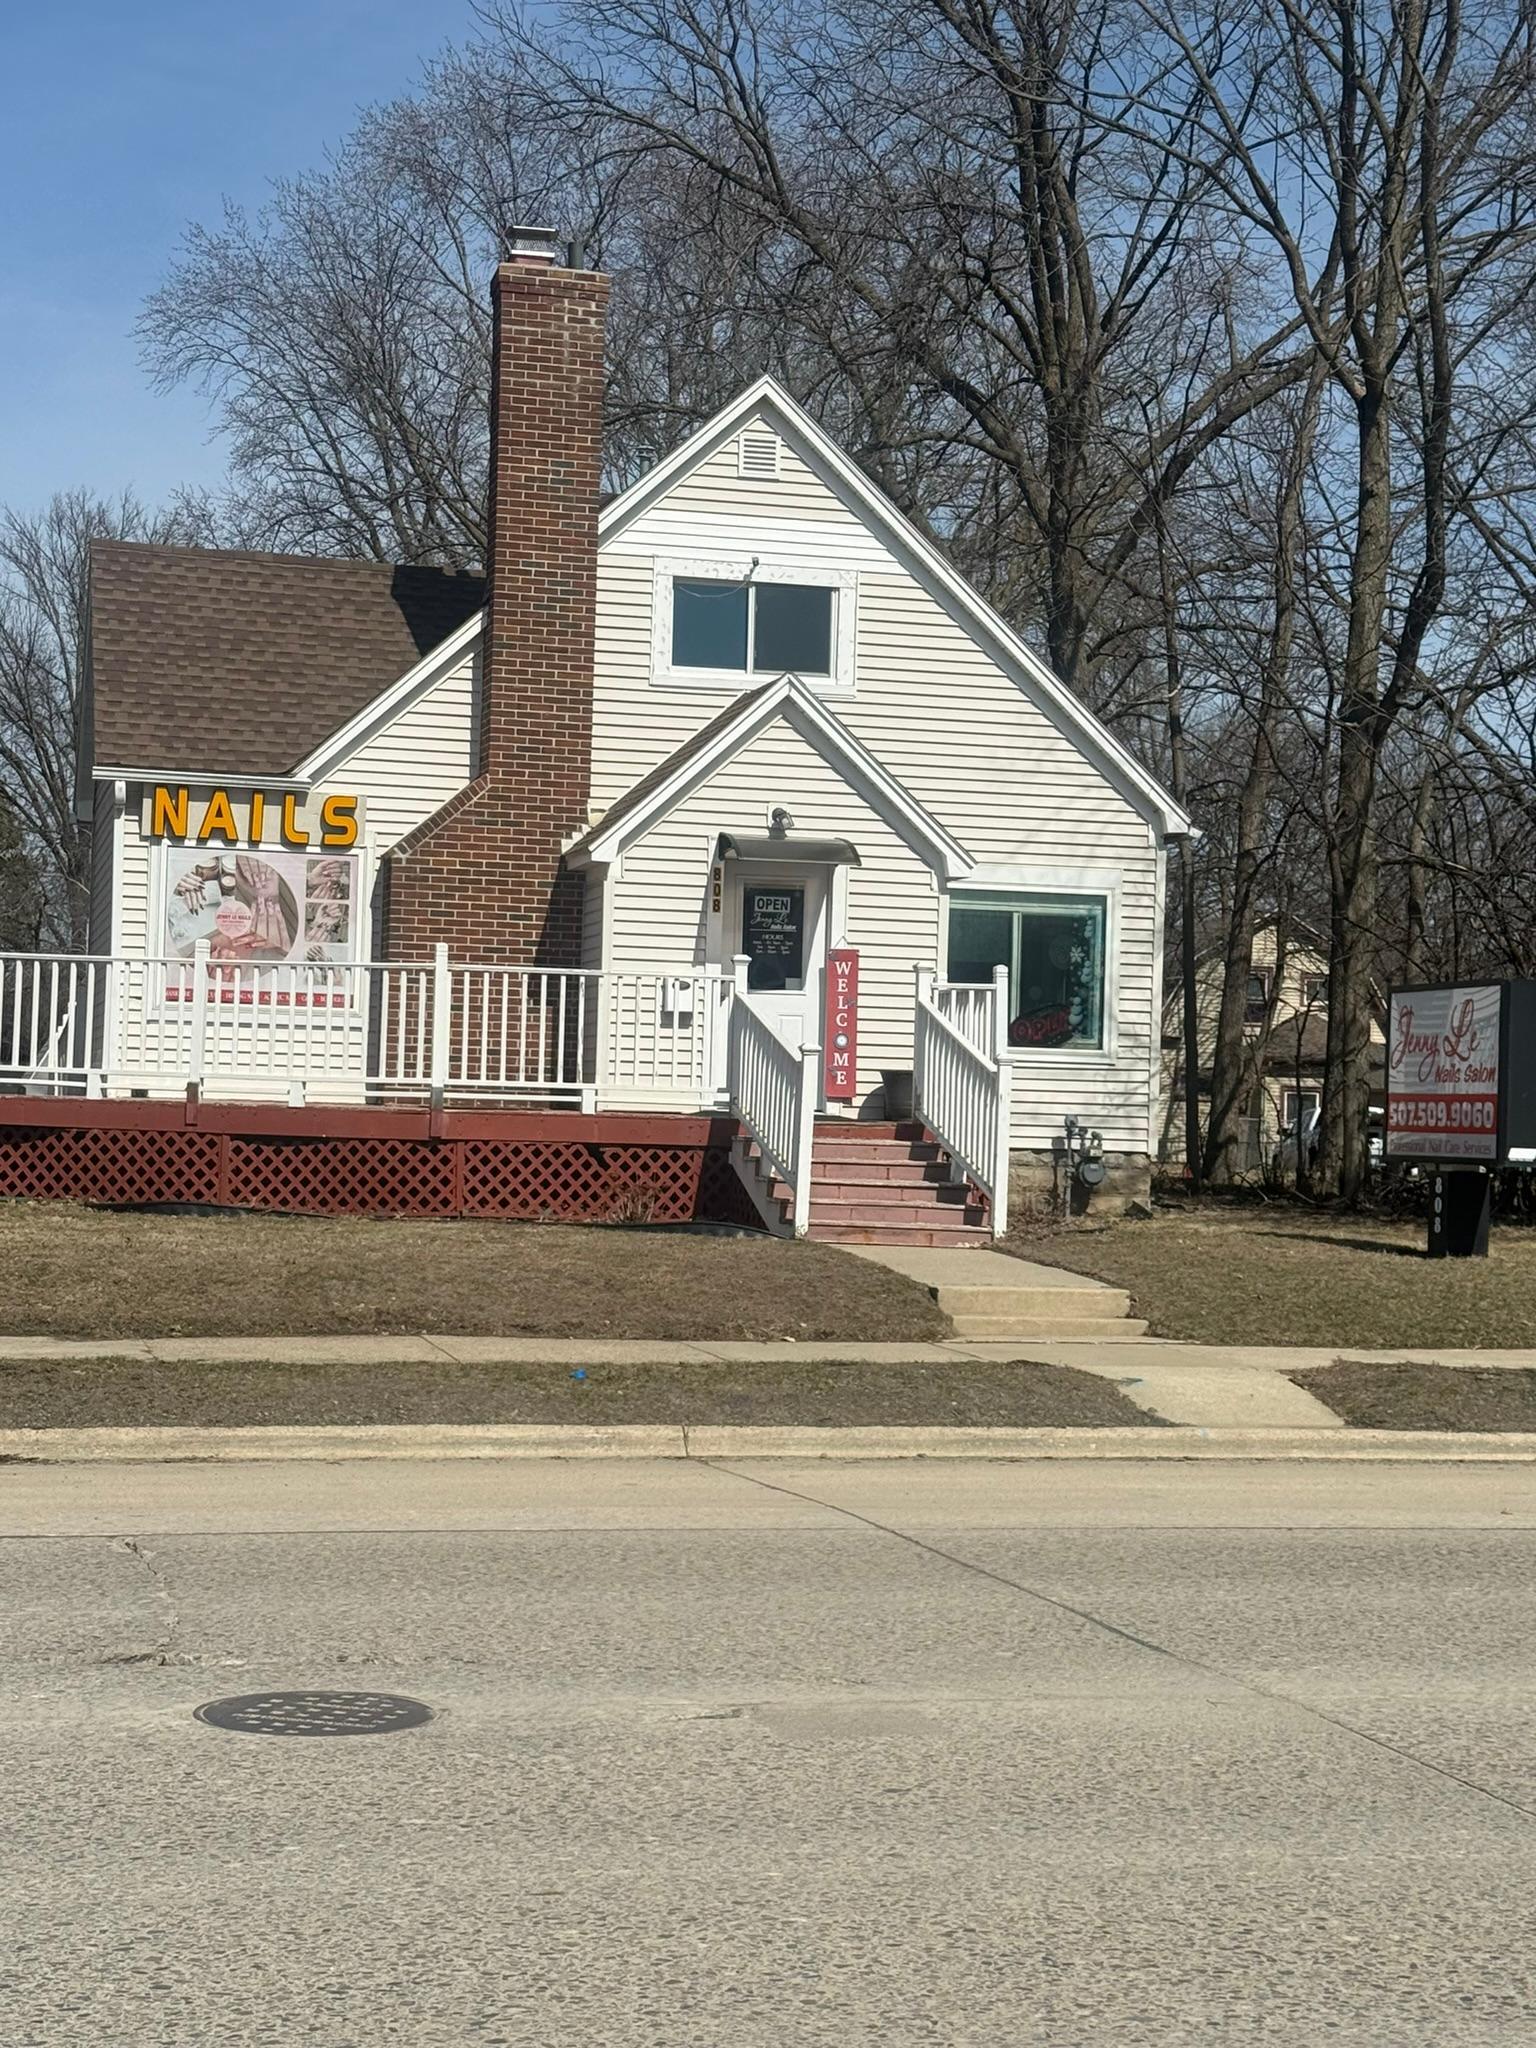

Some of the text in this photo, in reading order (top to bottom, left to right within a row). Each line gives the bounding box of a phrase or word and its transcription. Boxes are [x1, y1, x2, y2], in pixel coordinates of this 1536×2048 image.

[153, 785, 358, 846] NAILS
[713, 867, 721, 913] 808
[756, 898, 789, 911] OPEN
[1391, 999, 1480, 1081] Jenny Le
[1435, 1063, 1496, 1083] Nails Salon
[1389, 1101, 1494, 1128] 507.509.9060
[1434, 1176, 1442, 1233] 808
